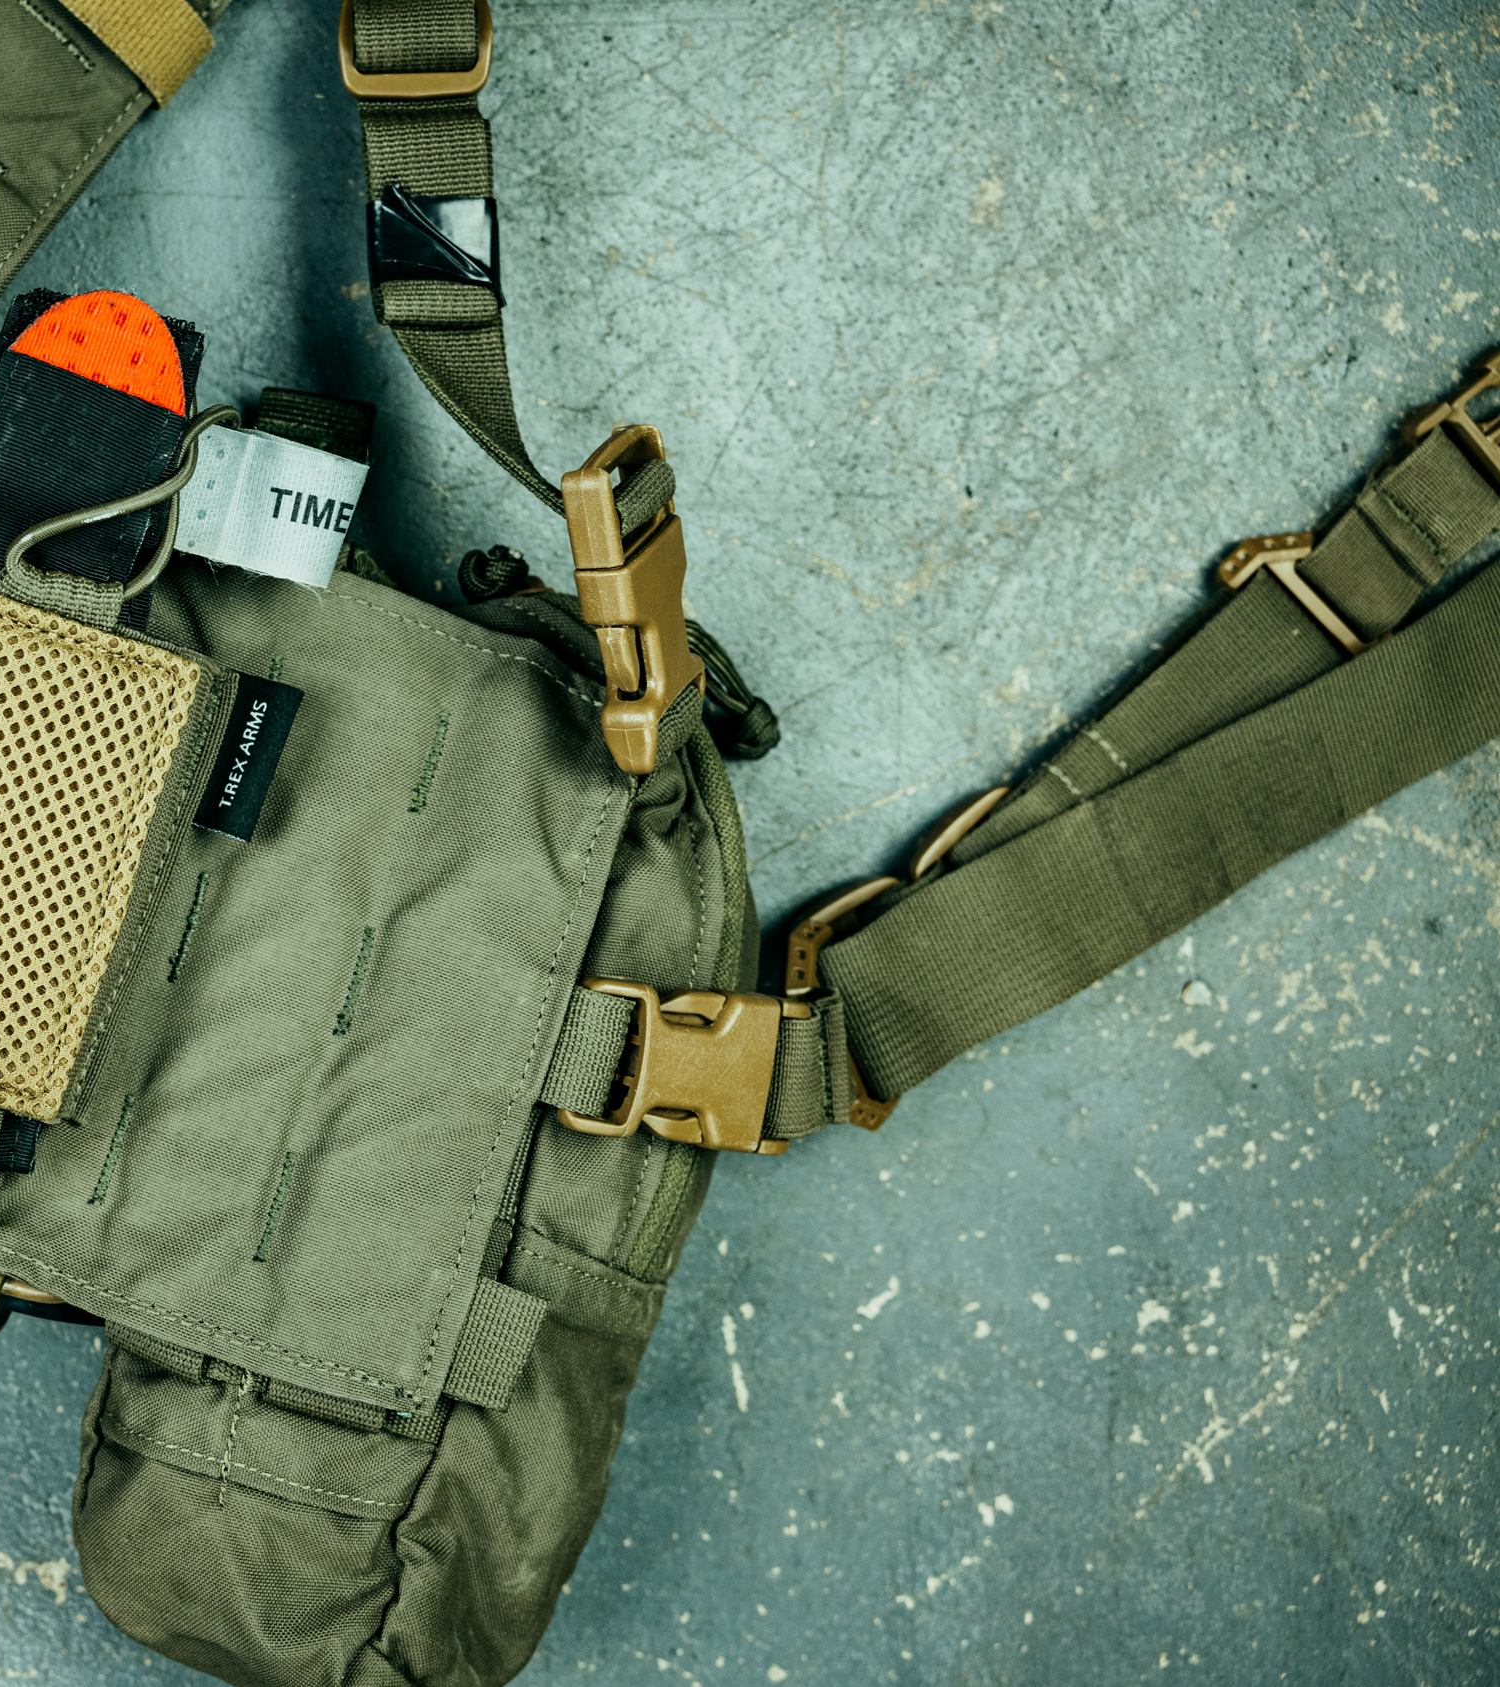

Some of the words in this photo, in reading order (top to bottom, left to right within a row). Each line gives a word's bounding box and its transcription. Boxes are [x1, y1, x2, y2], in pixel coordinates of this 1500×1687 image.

[270, 486, 355, 534] TIME
[219, 757, 248, 808] T.REX
[239, 700, 268, 756] ARMS
